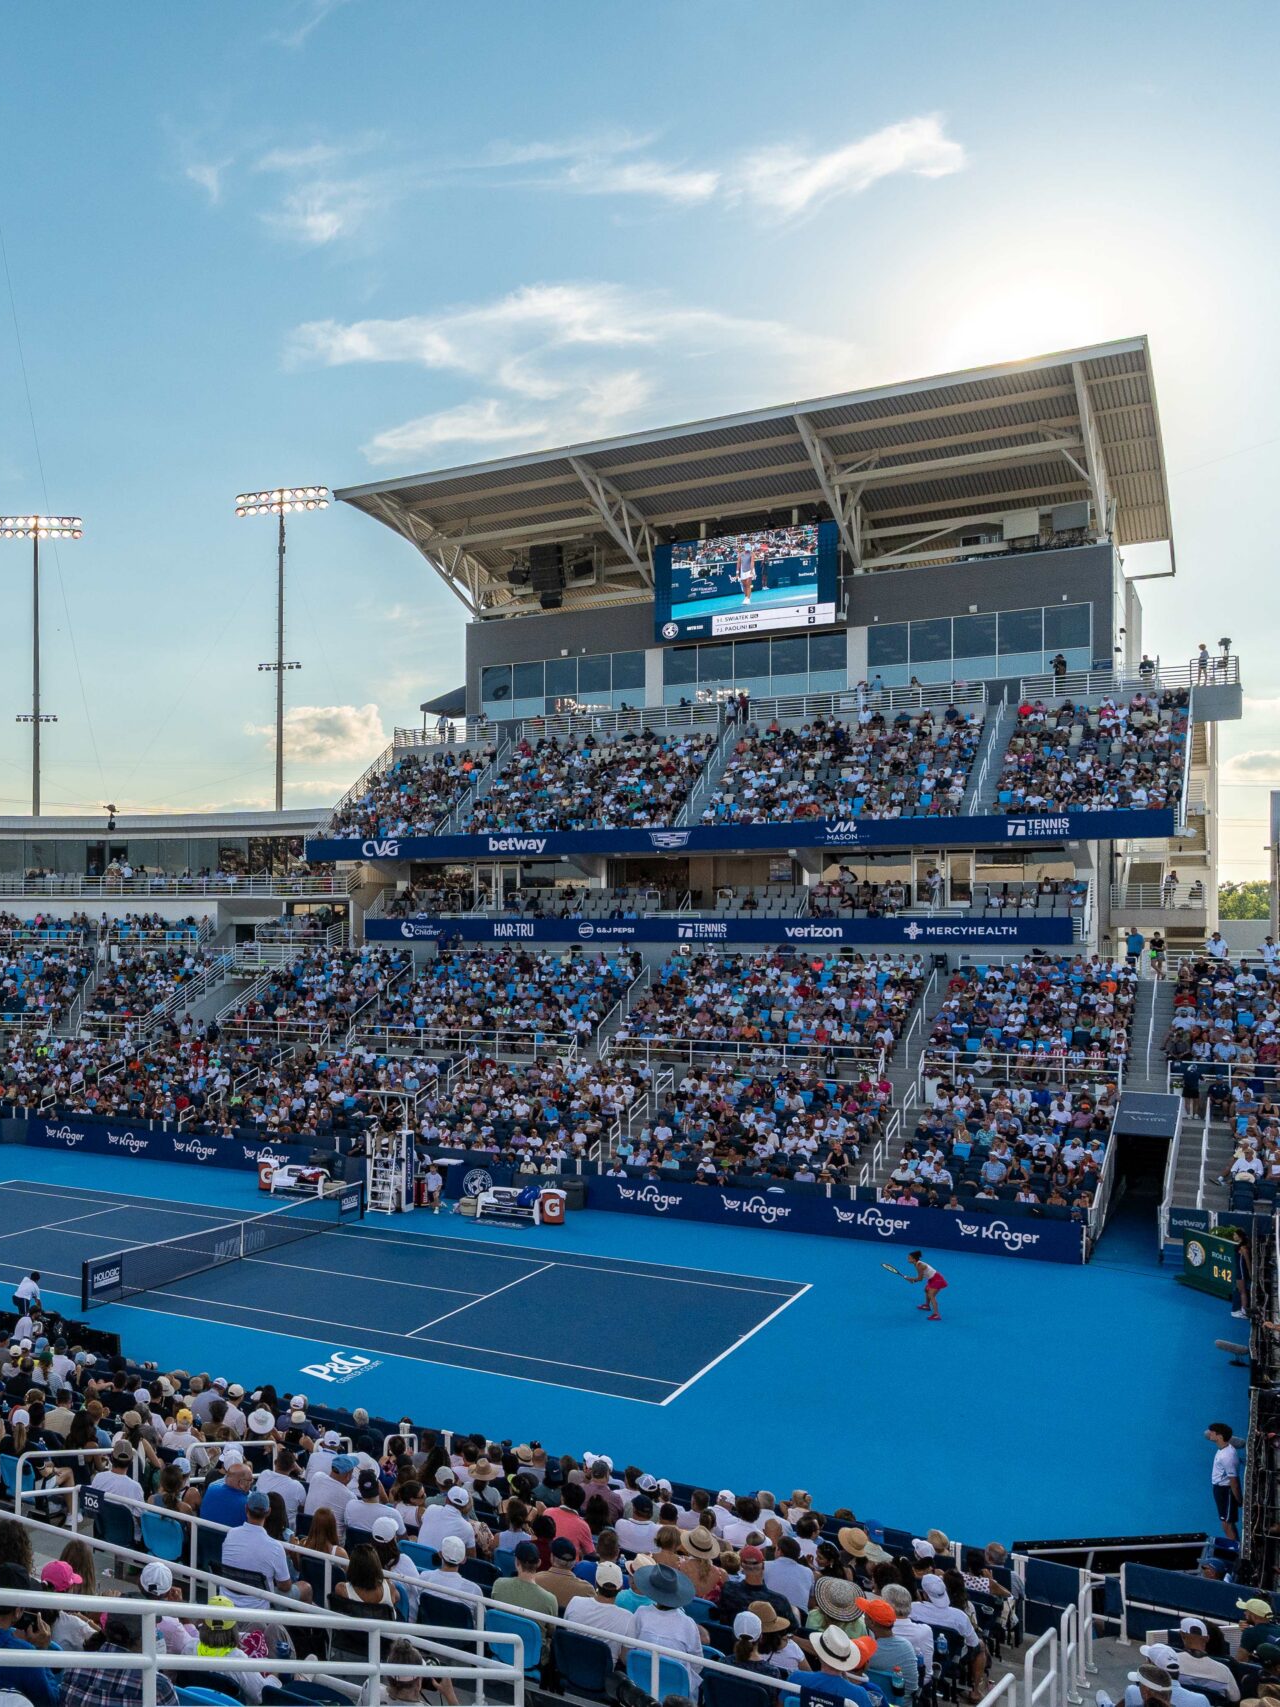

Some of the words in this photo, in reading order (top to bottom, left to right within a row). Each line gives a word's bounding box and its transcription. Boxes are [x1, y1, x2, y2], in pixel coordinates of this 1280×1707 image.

[1026, 818, 1070, 829] TENNIS
[826, 833, 858, 841] MASON
[1027, 828, 1070, 836] CHANNEL
[362, 840, 402, 857] CVG
[488, 837, 547, 853] betway
[493, 924, 534, 937] HAR-TRU
[693, 923, 727, 933] TENNIS
[785, 924, 843, 938] verizon
[926, 926, 1018, 935] MERCYHEALTH
[56, 1126, 84, 1146] Kroger
[119, 1133, 149, 1153] Kroger
[186, 1140, 218, 1161] Kroger
[636, 1185, 682, 1212] Kroger
[742, 1196, 792, 1223] Kroger
[857, 1207, 911, 1236] Kroger
[1171, 1218, 1206, 1230] betway
[981, 1220, 1040, 1251] Kroger
[1211, 1251, 1232, 1263] ROLEX
[93, 1267, 120, 1283] HOLOGIC
[1213, 1265, 1232, 1282] 0:42
[298, 1351, 371, 1383] P&G
[84, 1496, 99, 1509] 106
[810, 1696, 834, 1706] SECTION
